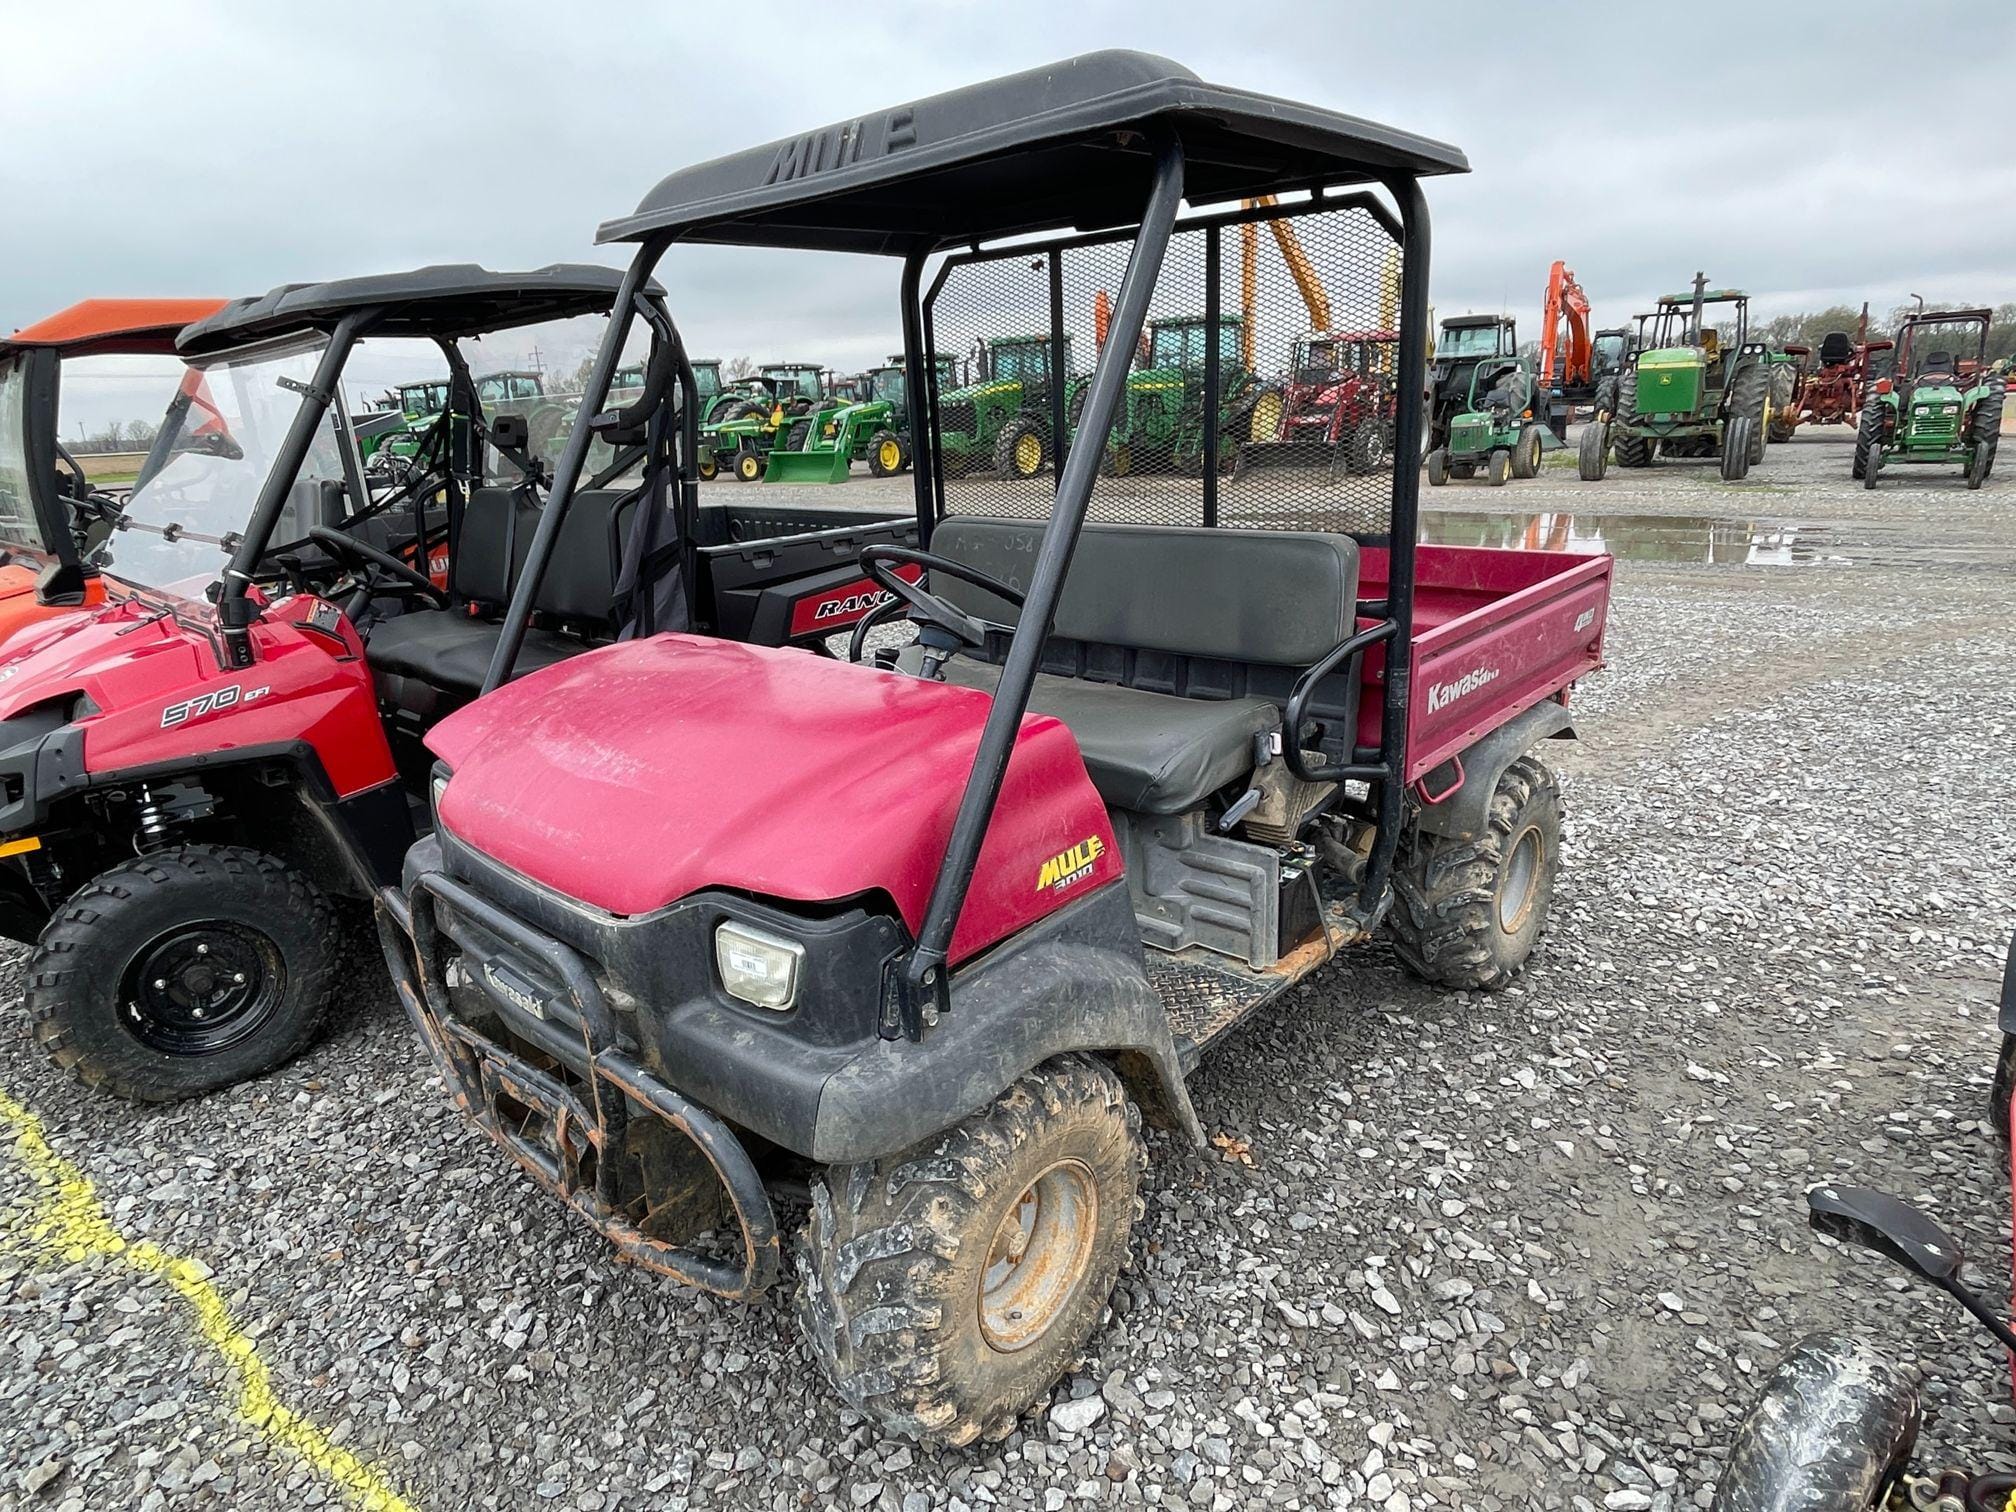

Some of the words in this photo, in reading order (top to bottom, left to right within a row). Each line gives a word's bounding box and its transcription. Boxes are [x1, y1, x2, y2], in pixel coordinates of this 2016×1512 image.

[814, 589, 899, 620] RANG
[160, 684, 241, 728] 570
[244, 685, 271, 701] EFI
[1036, 834, 1106, 892] MULE
